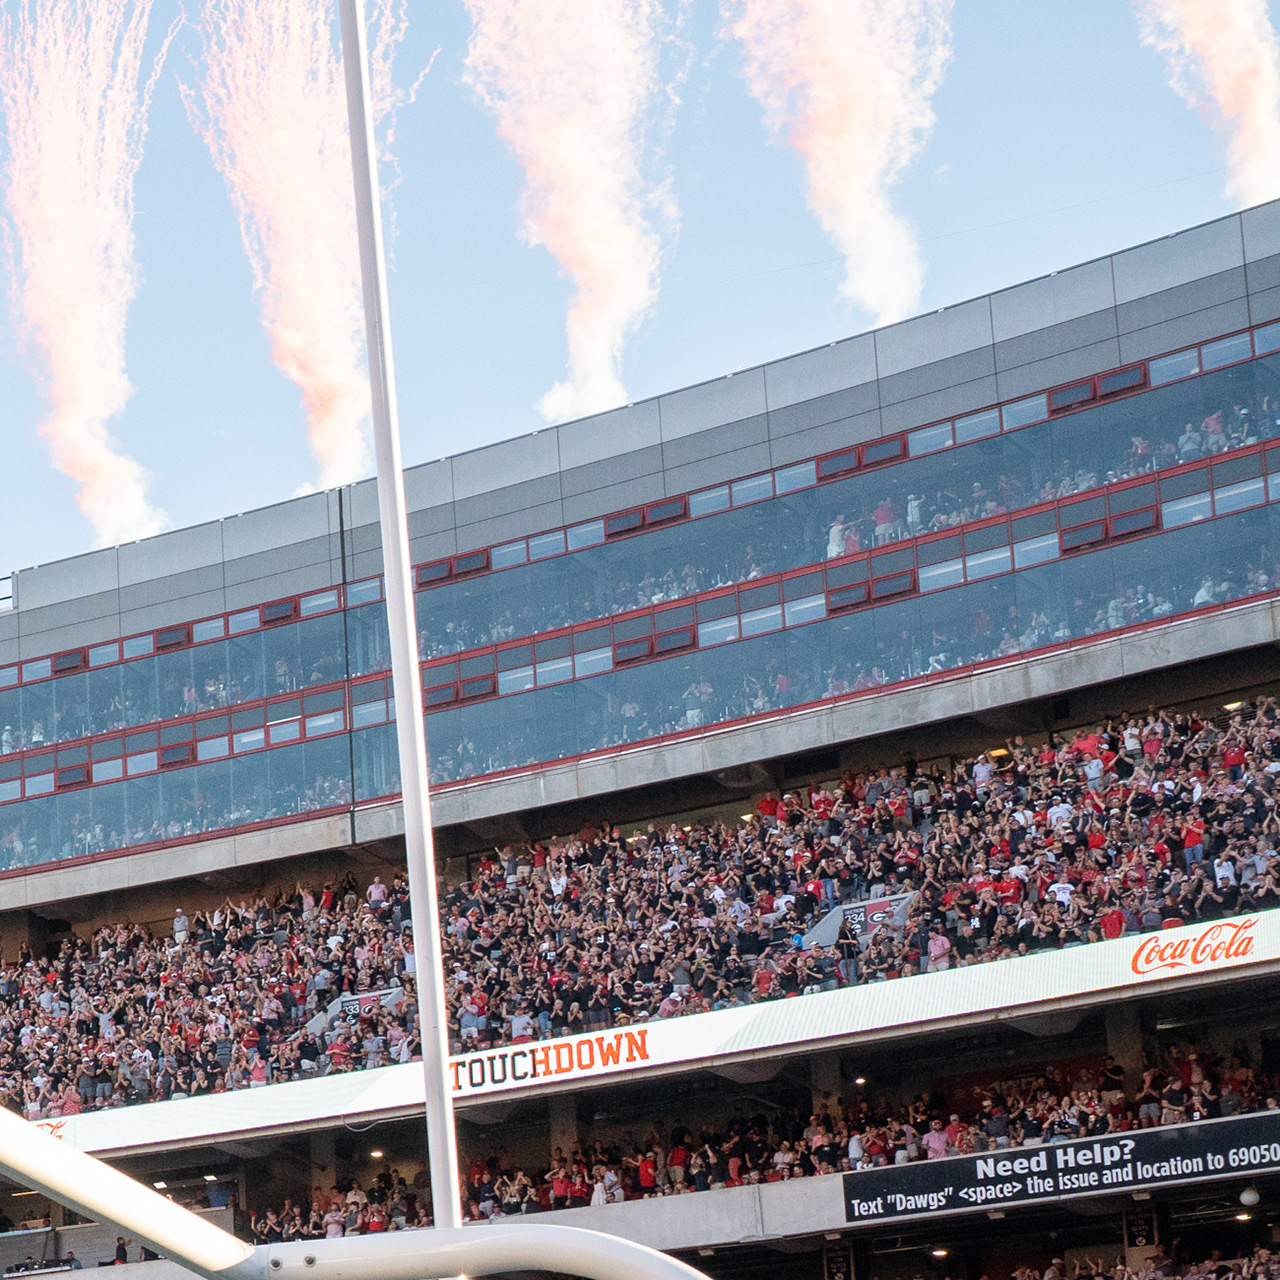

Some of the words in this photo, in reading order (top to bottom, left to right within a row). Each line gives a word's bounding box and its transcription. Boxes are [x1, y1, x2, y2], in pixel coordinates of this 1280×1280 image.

[1131, 918, 1260, 974] Coca-Cola
[449, 1029, 649, 1091] TOUCHDOWN
[852, 1198, 883, 1217] Text
[887, 1187, 953, 1212] "Dawgs"
[958, 1182, 1023, 1206] <space>
[1027, 1175, 1054, 1194] the
[1058, 1171, 1098, 1191] issue
[1102, 1161, 1133, 1184] and
[1137, 1156, 1203, 1180] location
[1207, 1153, 1224, 1171] to
[1229, 1143, 1280, 1168] 69050
[976, 1151, 1046, 1180] Need
[1057, 1140, 1135, 1171] Help?
